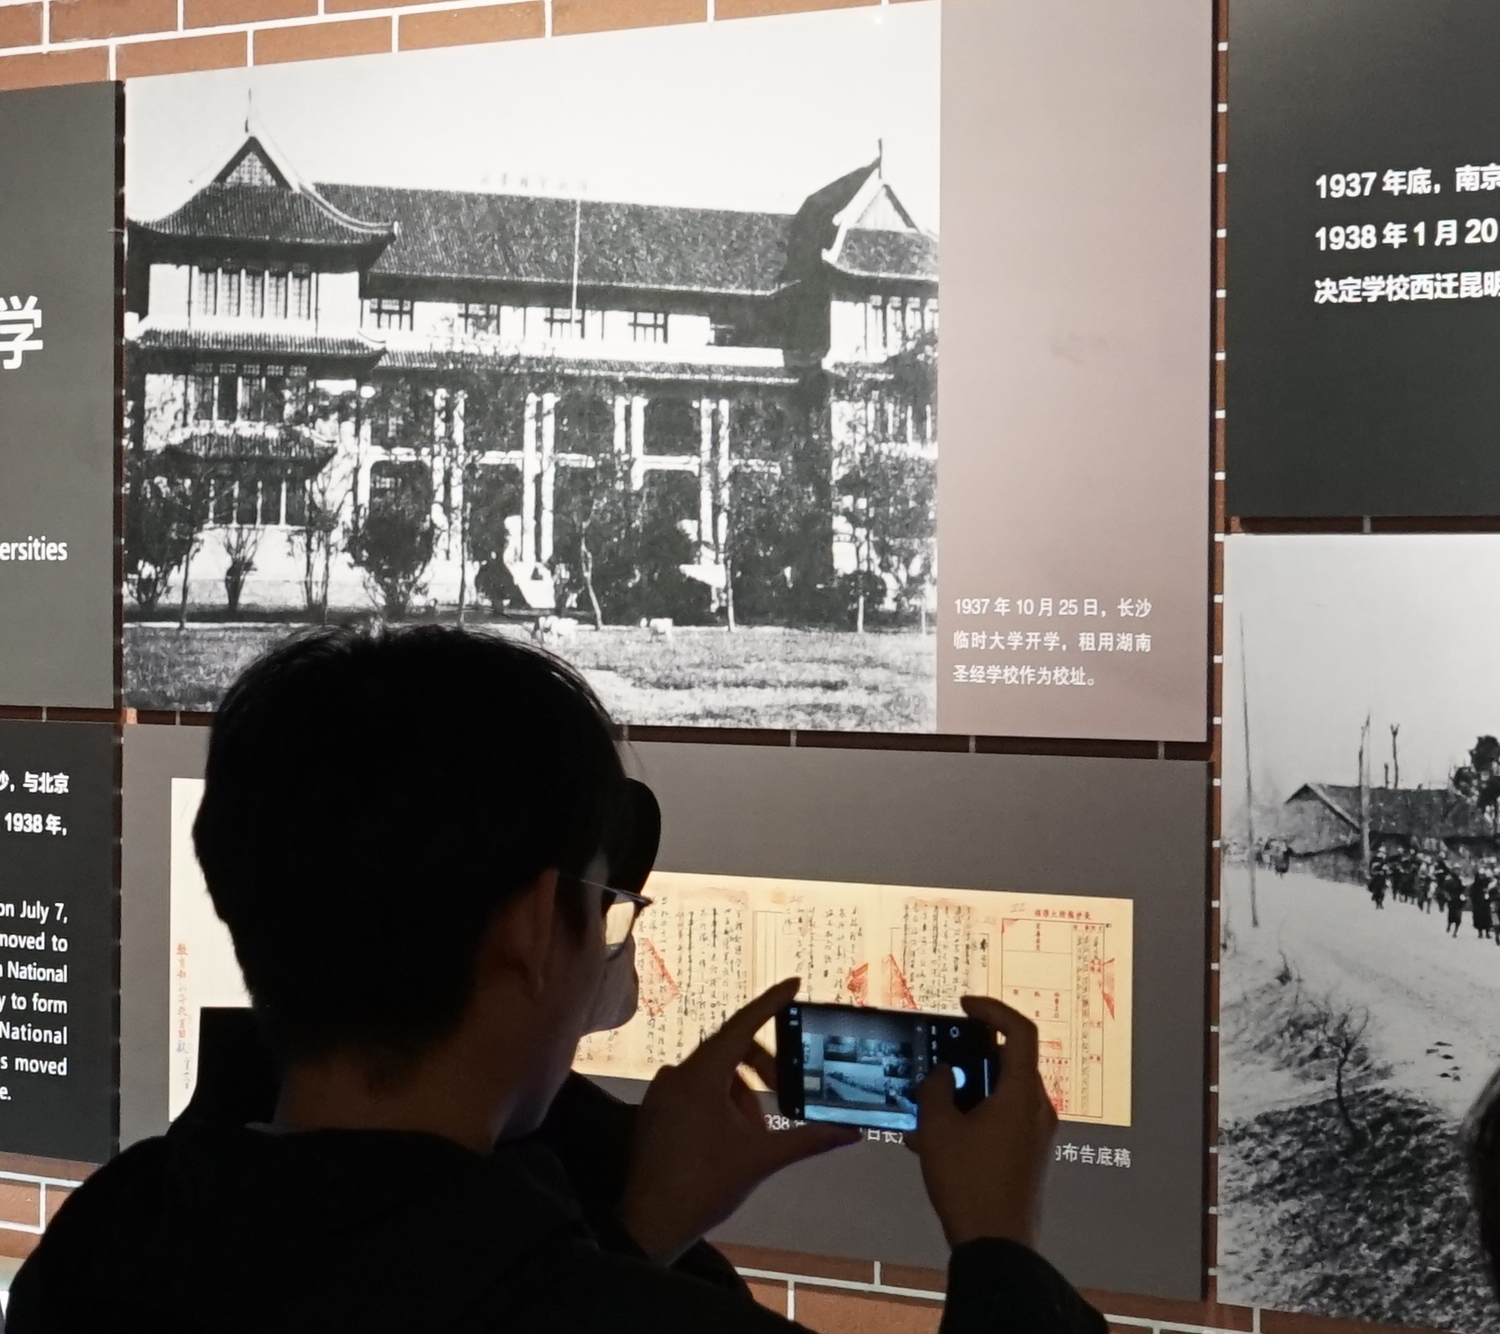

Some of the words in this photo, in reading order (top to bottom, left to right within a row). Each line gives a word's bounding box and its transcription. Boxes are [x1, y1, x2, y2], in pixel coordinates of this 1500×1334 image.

[953, 665, 1094, 686] 圣经学校作为校址。
[20, 900, 49, 924] July
[55, 903, 68, 924] 7,
[52, 935, 68, 952] to
[7, 961, 67, 983] National
[11, 993, 26, 1010] to
[32, 992, 67, 1014] form
[0, 1021, 67, 1044] National
[15, 1057, 67, 1075] moved
